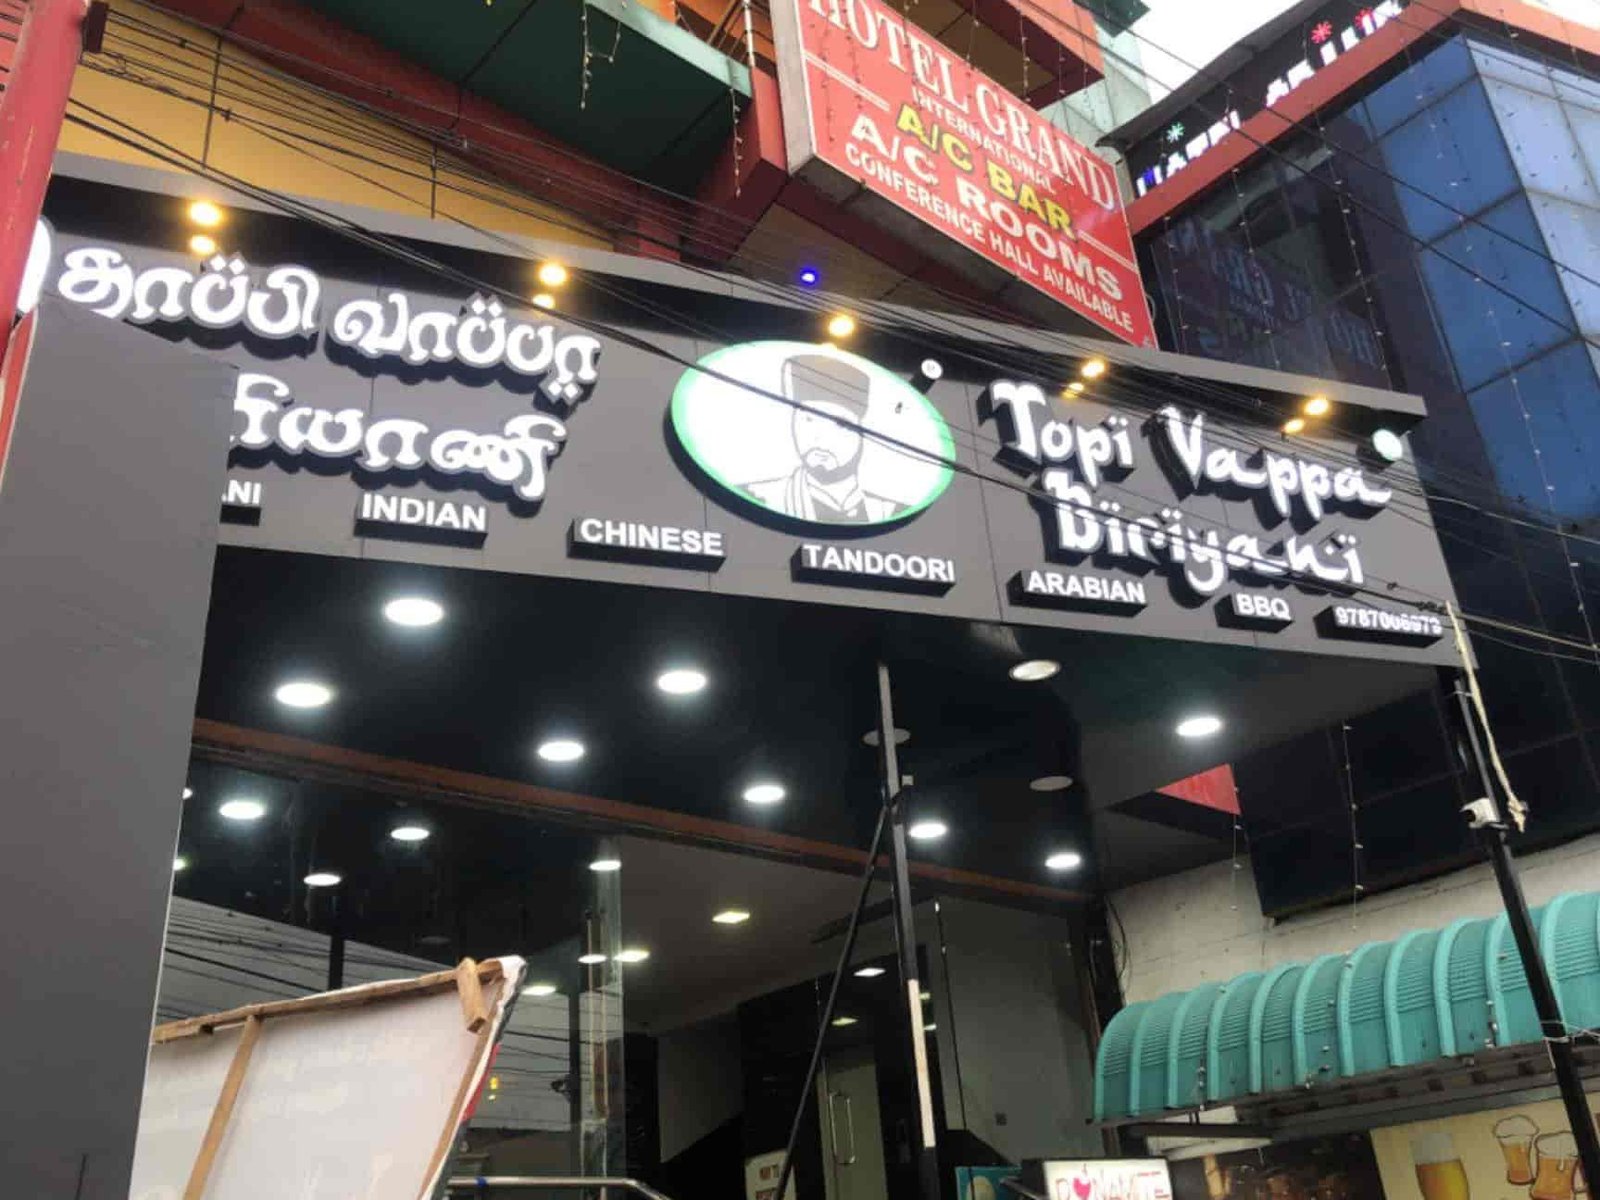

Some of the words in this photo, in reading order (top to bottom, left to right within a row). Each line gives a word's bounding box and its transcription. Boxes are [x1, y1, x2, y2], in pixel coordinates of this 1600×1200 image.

[897, 104, 973, 171] A/C
[987, 160, 1077, 241] BAR
[911, 86, 1056, 196] INTERNATIONAL
[976, 84, 1114, 210] GRAND
[845, 143, 986, 244] CONFERENCE
[989, 230, 1039, 276] HALL
[1043, 264, 1134, 333] AVAILABLE
[956, 176, 1122, 300] ROOMS
[362, 492, 487, 532] INDIAN
[579, 517, 724, 556] CHINESE
[802, 544, 955, 583] TANDOORI
[1026, 570, 1146, 604] ARABIAN
[1235, 593, 1292, 620] BBQ
